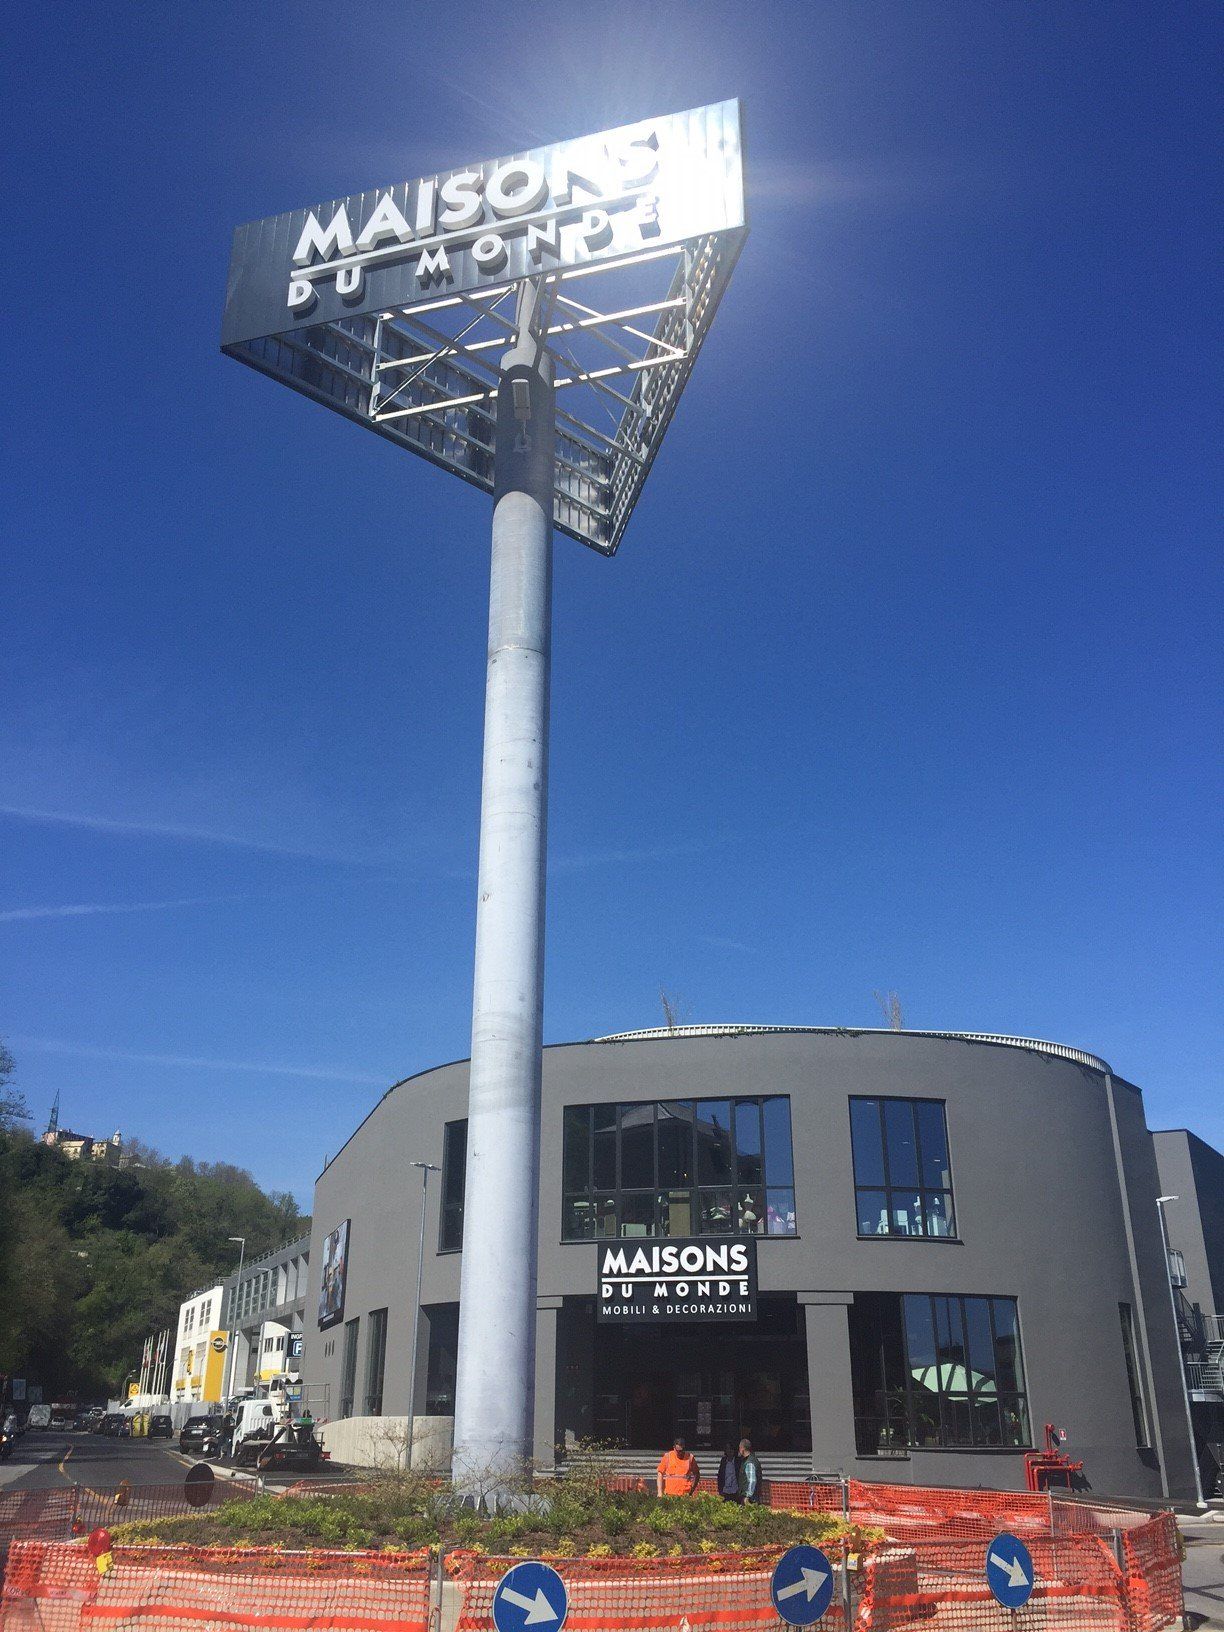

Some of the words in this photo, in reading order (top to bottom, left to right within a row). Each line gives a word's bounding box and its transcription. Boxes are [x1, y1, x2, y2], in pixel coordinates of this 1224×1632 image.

[293, 131, 660, 266] MAISONS
[287, 262, 365, 308] DU
[415, 194, 661, 280] MONDE
[602, 1244, 748, 1275] MAISONS
[601, 1283, 633, 1298] DU
[653, 1281, 749, 1298] MONDE
[602, 1305, 646, 1315] MOBILI
[652, 1305, 660, 1314] &
[666, 1303, 751, 1314] DECORAZIONI
